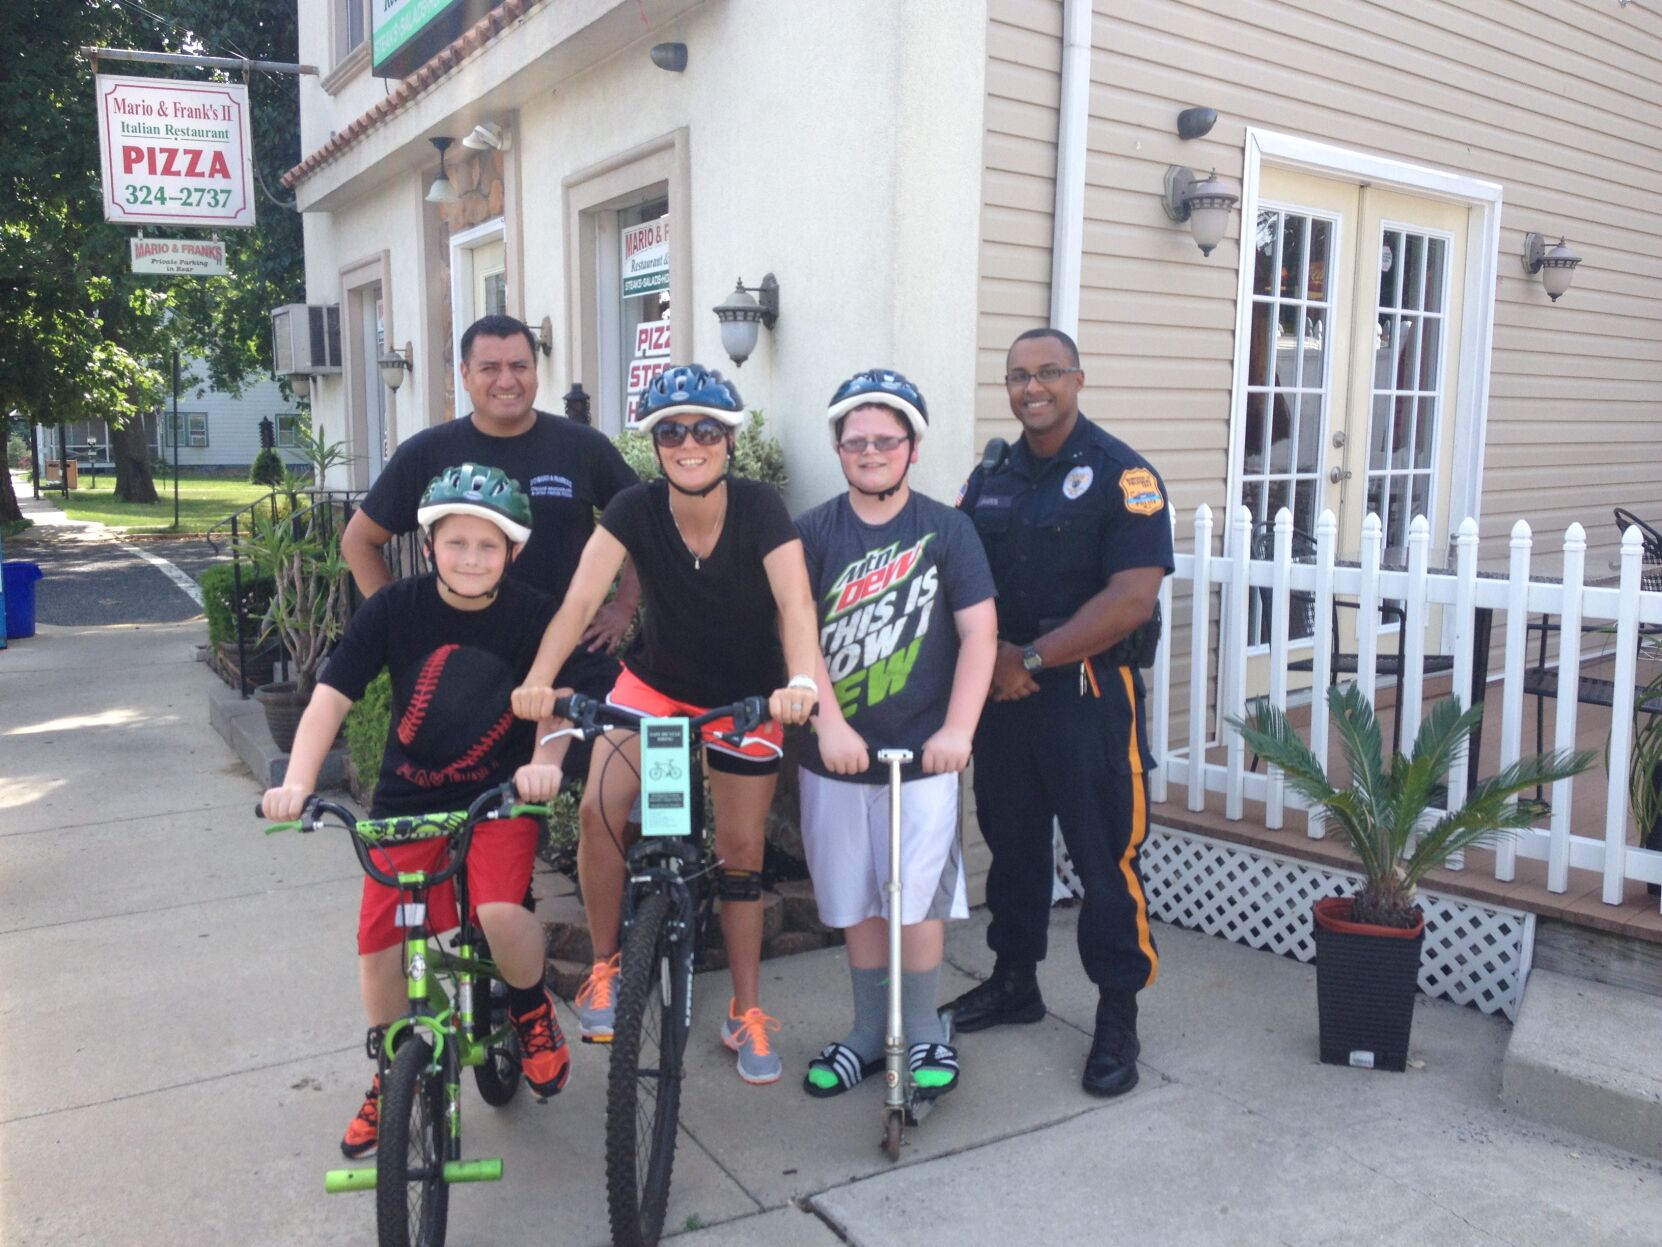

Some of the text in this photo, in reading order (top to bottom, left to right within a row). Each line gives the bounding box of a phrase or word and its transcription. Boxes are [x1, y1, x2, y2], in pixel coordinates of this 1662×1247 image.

[113, 97, 234, 121] Mario & Frank's II
[120, 121, 231, 139] Italian Restaurant
[122, 145, 232, 179] PIZZA
[125, 184, 232, 208] 324-2737
[135, 242, 170, 260] MARIO
[171, 243, 178, 253] &
[625, 227, 653, 260] MARIO
[179, 259, 208, 268] Parking
[630, 255, 663, 273] Restaurant
[820, 564, 939, 655] THIS IS
[824, 598, 936, 684] OW I
[832, 637, 925, 719] EW
